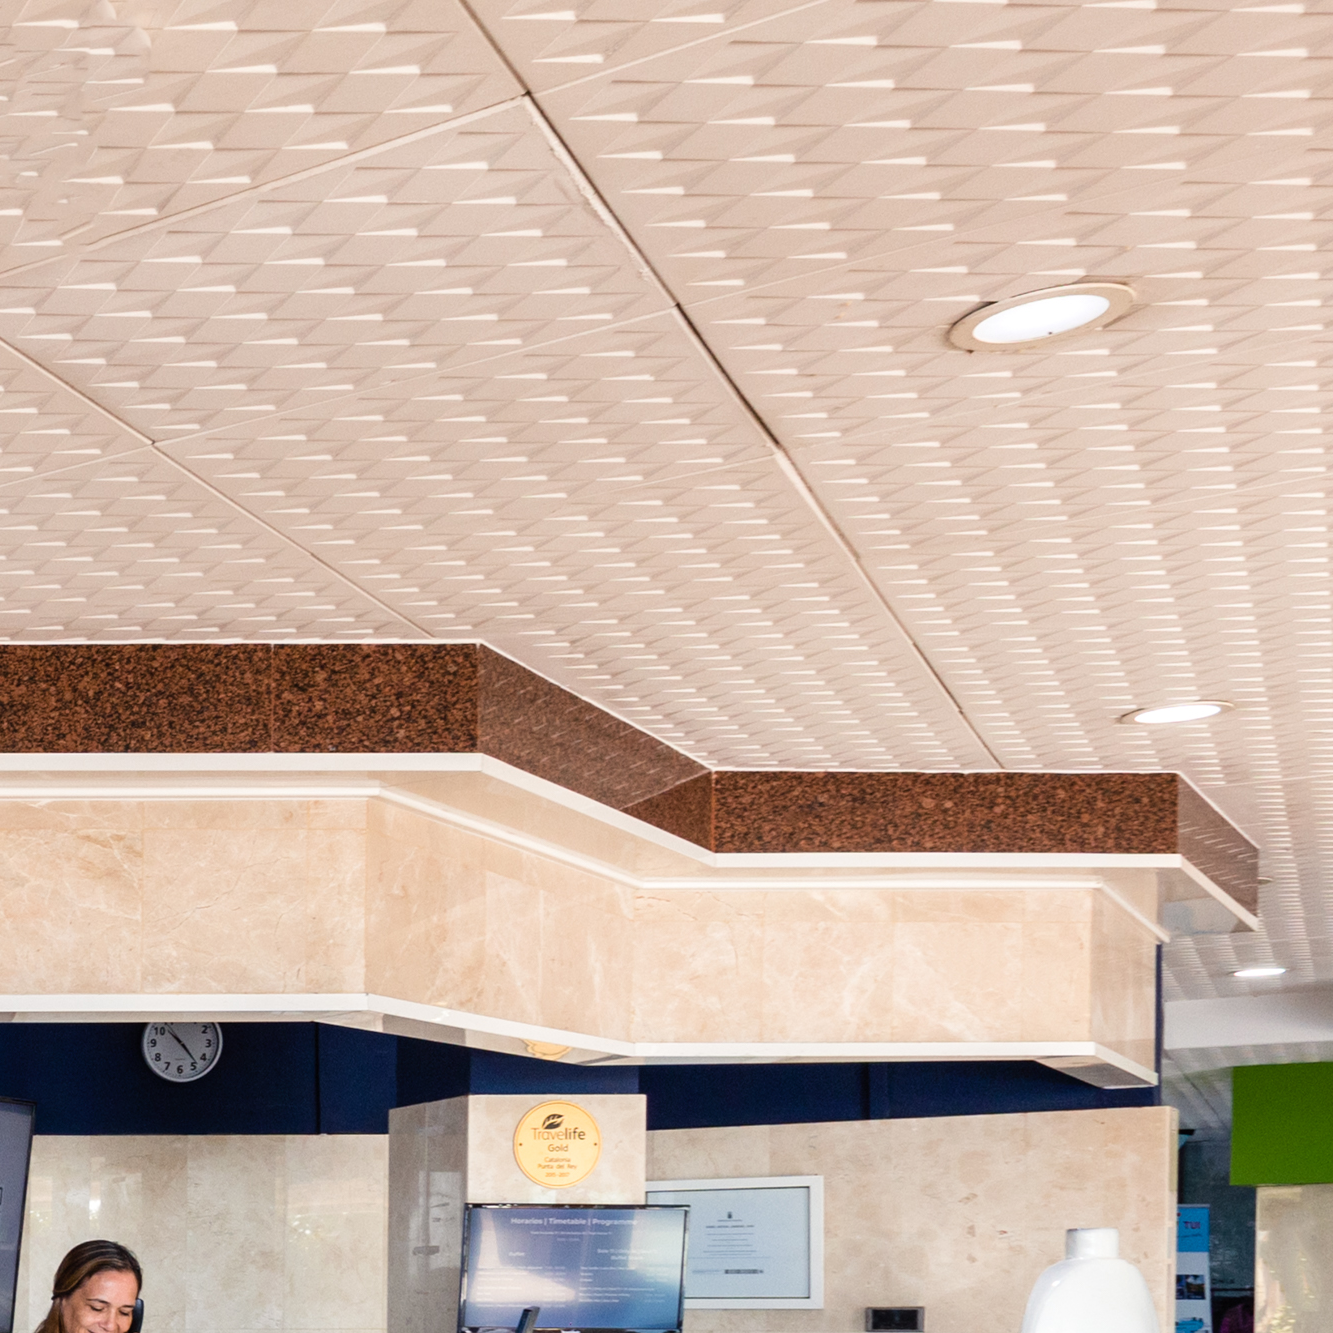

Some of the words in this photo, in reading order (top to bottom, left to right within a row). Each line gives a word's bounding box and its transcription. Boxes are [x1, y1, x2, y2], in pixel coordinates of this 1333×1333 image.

[154, 1026, 166, 1036] 10
[201, 1025, 208, 1034] 2
[150, 1039, 157, 1048] 9
[205, 1039, 212, 1048] 3
[155, 1052, 161, 1062] 8
[200, 1053, 207, 1062] 4
[164, 1062, 171, 1070] 7
[177, 1065, 183, 1074] 6
[190, 1062, 197, 1070] 5
[531, 1127, 586, 1140] Travelife
[547, 1144, 569, 1152] Gold
